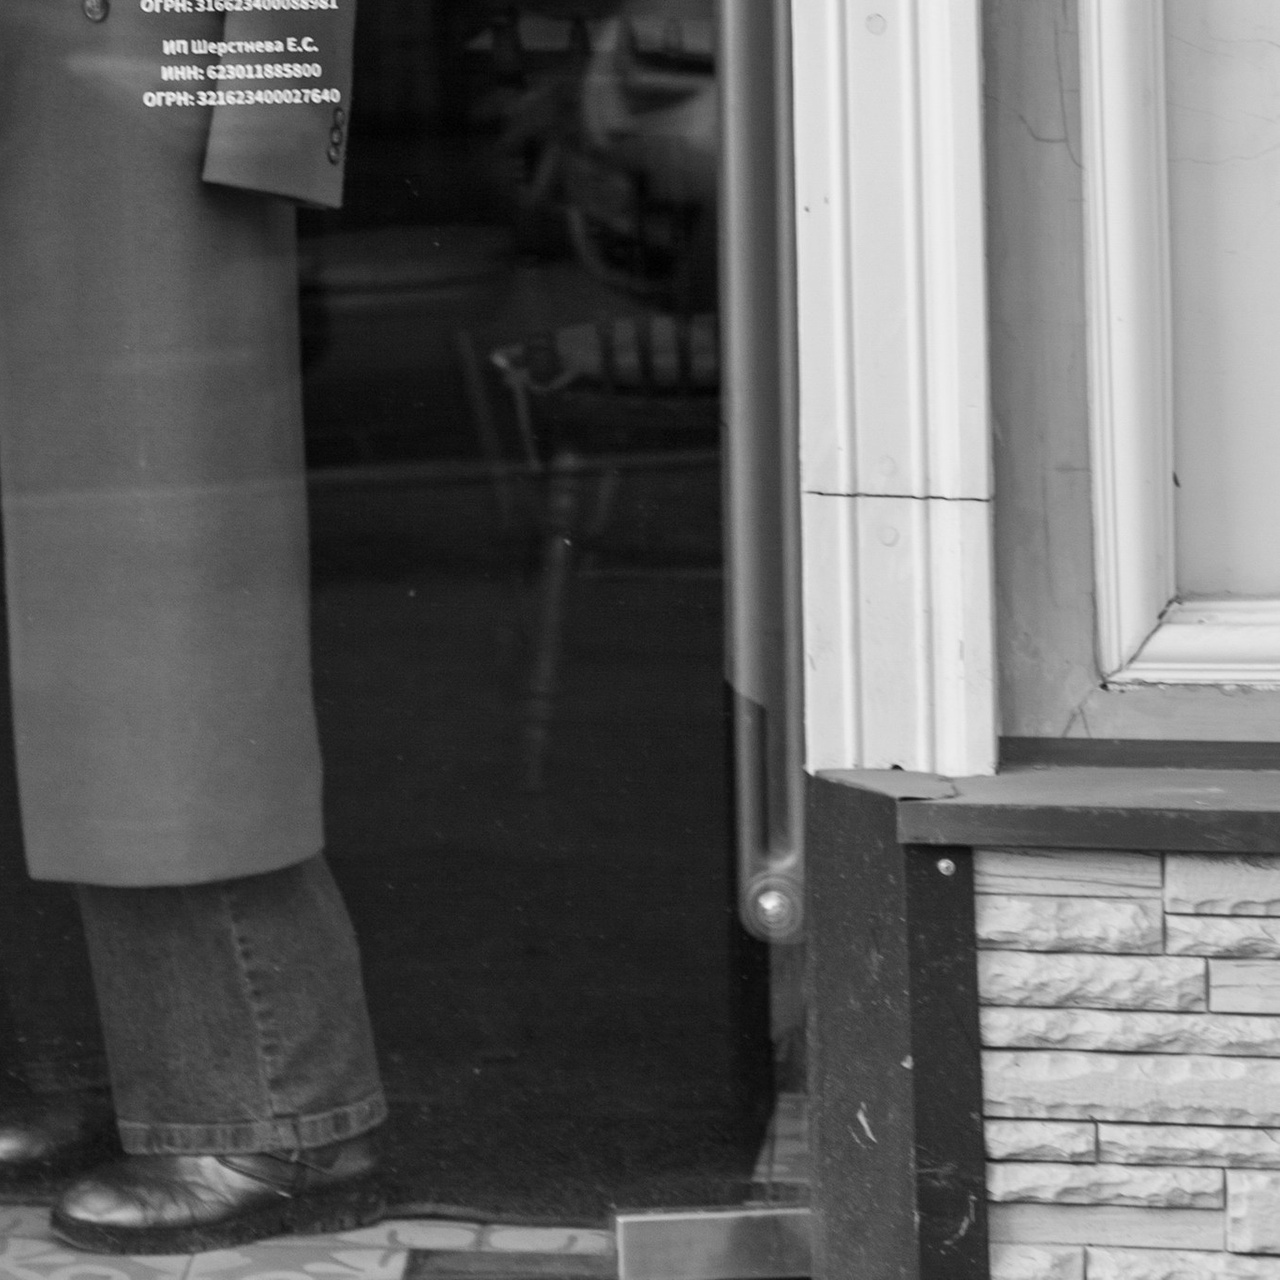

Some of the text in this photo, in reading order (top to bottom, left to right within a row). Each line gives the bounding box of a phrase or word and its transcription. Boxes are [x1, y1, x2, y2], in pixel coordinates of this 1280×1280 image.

[162, 37, 319, 57] ИП Шерстнева Е.С.
[161, 63, 322, 80] ИНН: 623011885800
[143, 88, 341, 107] ОГРН: 321623400027640
